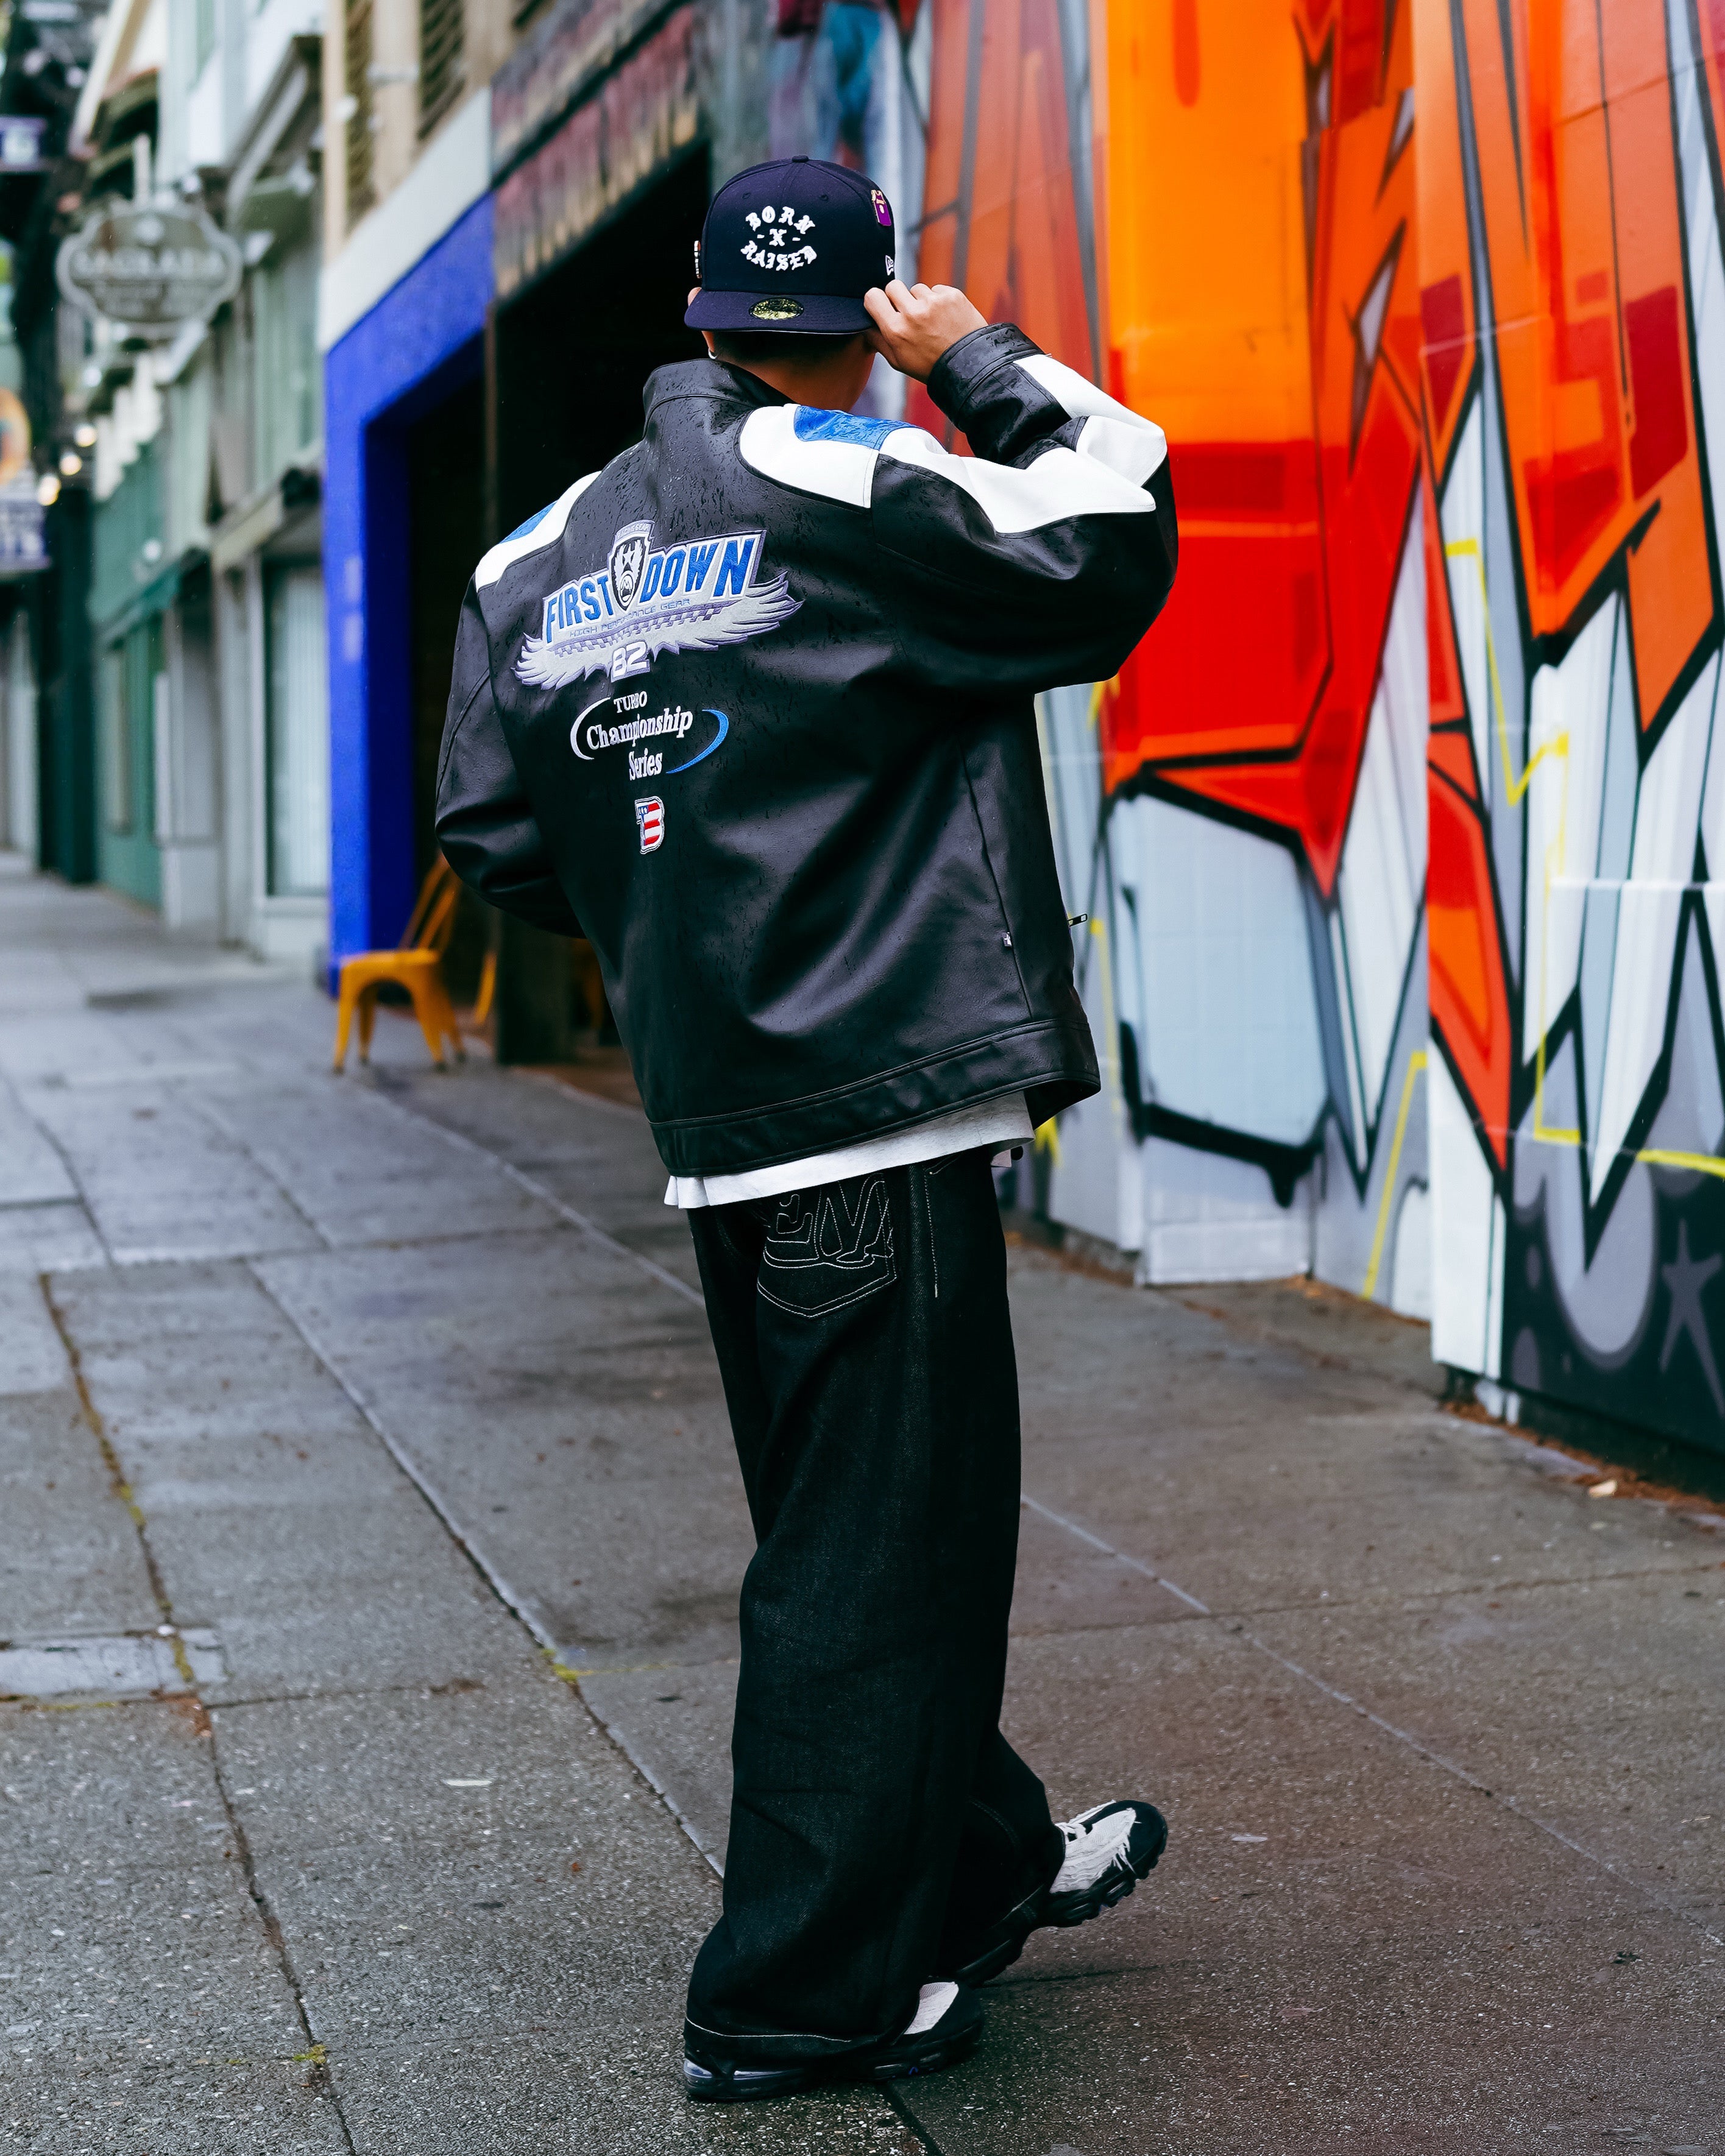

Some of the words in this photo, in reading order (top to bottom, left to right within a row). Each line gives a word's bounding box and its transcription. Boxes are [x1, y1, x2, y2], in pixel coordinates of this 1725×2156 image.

[745, 206, 816, 235] BORN
[740, 240, 817, 271] RAISED
[546, 574, 615, 645] FIRST
[639, 537, 756, 604] DOWN
[570, 627, 598, 637] HIGH
[661, 598, 691, 610] GEAR
[586, 705, 693, 750] Championship
[629, 748, 663, 780] Series
